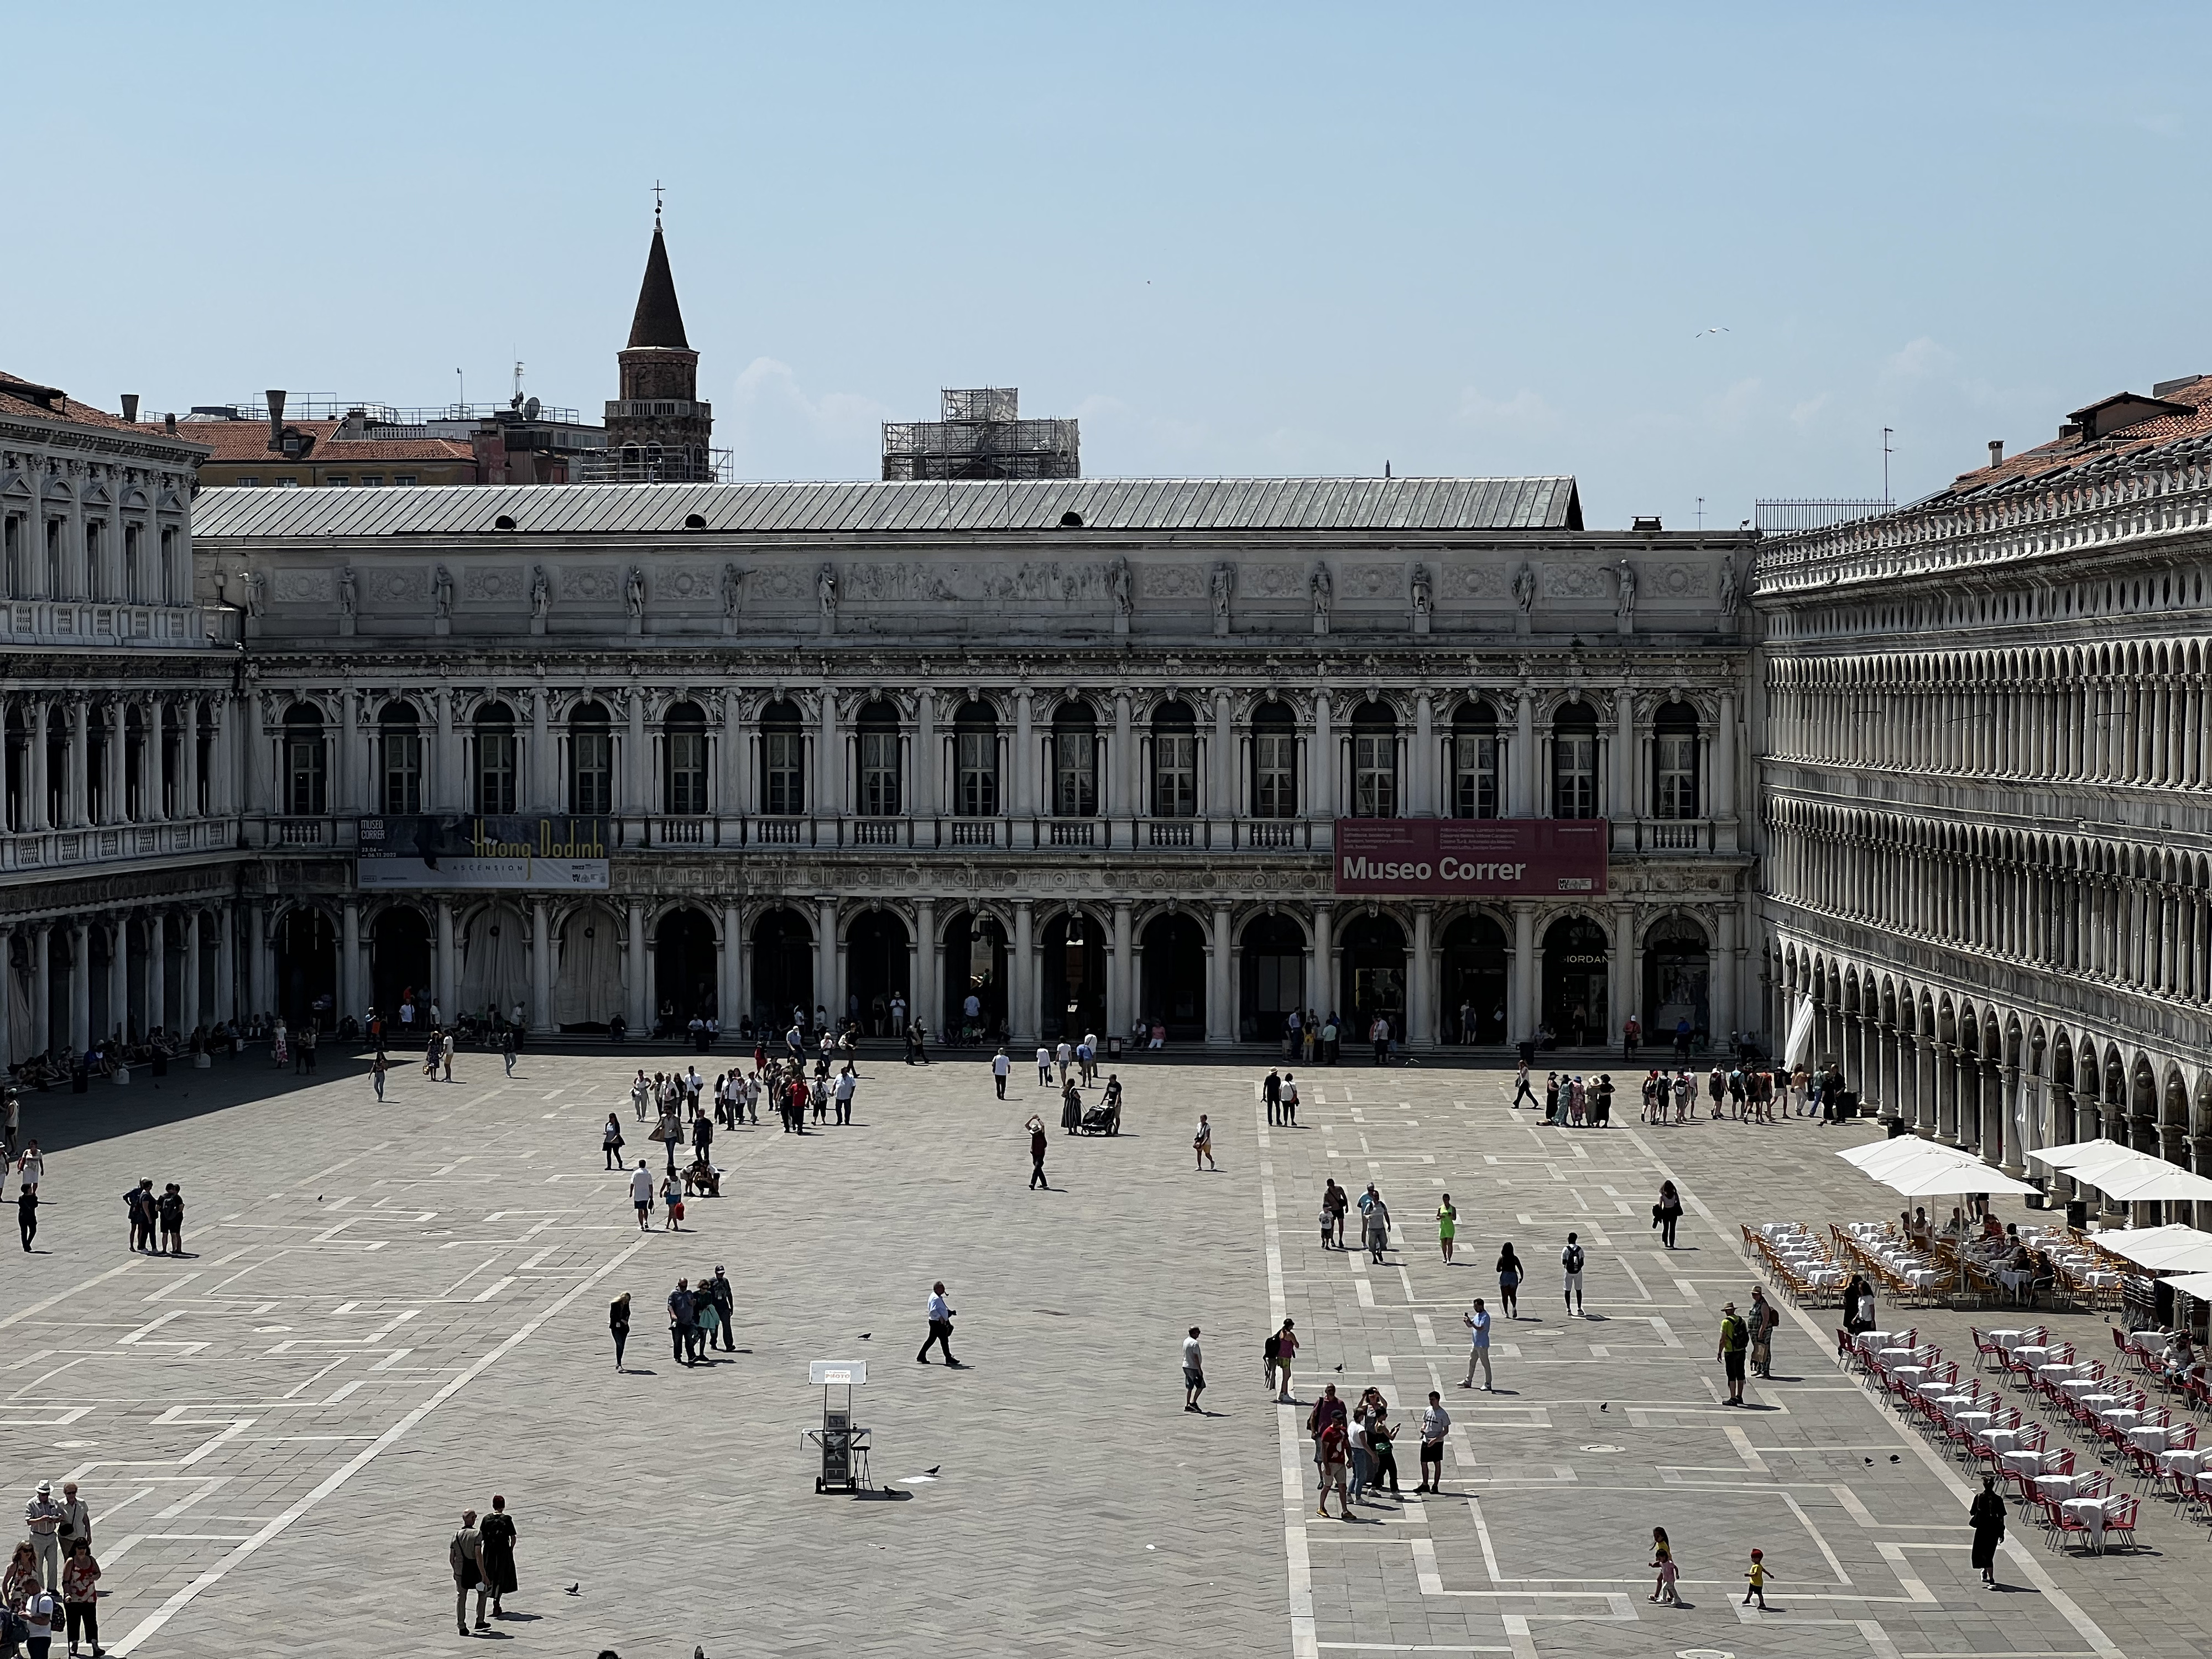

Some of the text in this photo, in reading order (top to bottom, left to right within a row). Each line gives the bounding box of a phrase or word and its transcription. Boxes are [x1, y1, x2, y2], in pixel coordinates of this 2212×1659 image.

[361, 820, 383, 830] MUSEO
[361, 830, 385, 839] CORRER
[540, 819, 603, 858] Dodinh
[1343, 856, 1526, 881] Museo Correr
